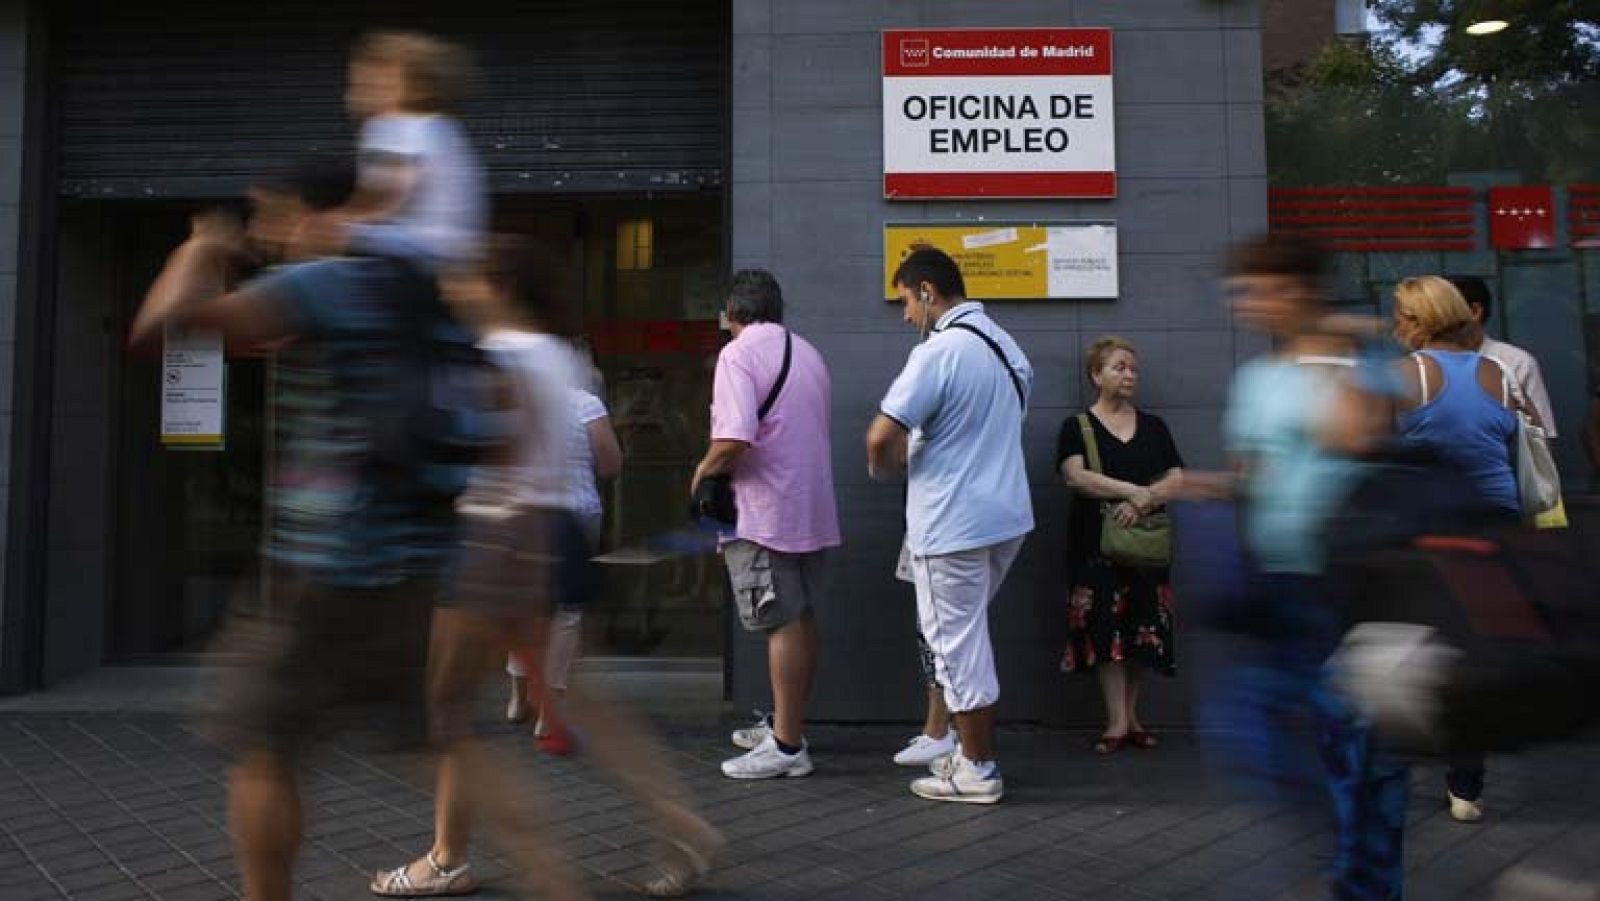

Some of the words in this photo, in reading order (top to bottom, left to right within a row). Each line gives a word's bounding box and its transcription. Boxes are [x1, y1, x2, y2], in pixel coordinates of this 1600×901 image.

[933, 45, 1015, 59] Comunidad
[1020, 45, 1038, 58] de
[1043, 45, 1095, 58] Madrid
[903, 94, 1040, 121] OFICINA
[1050, 94, 1095, 120] DE
[930, 127, 1069, 153] EMPLEO
